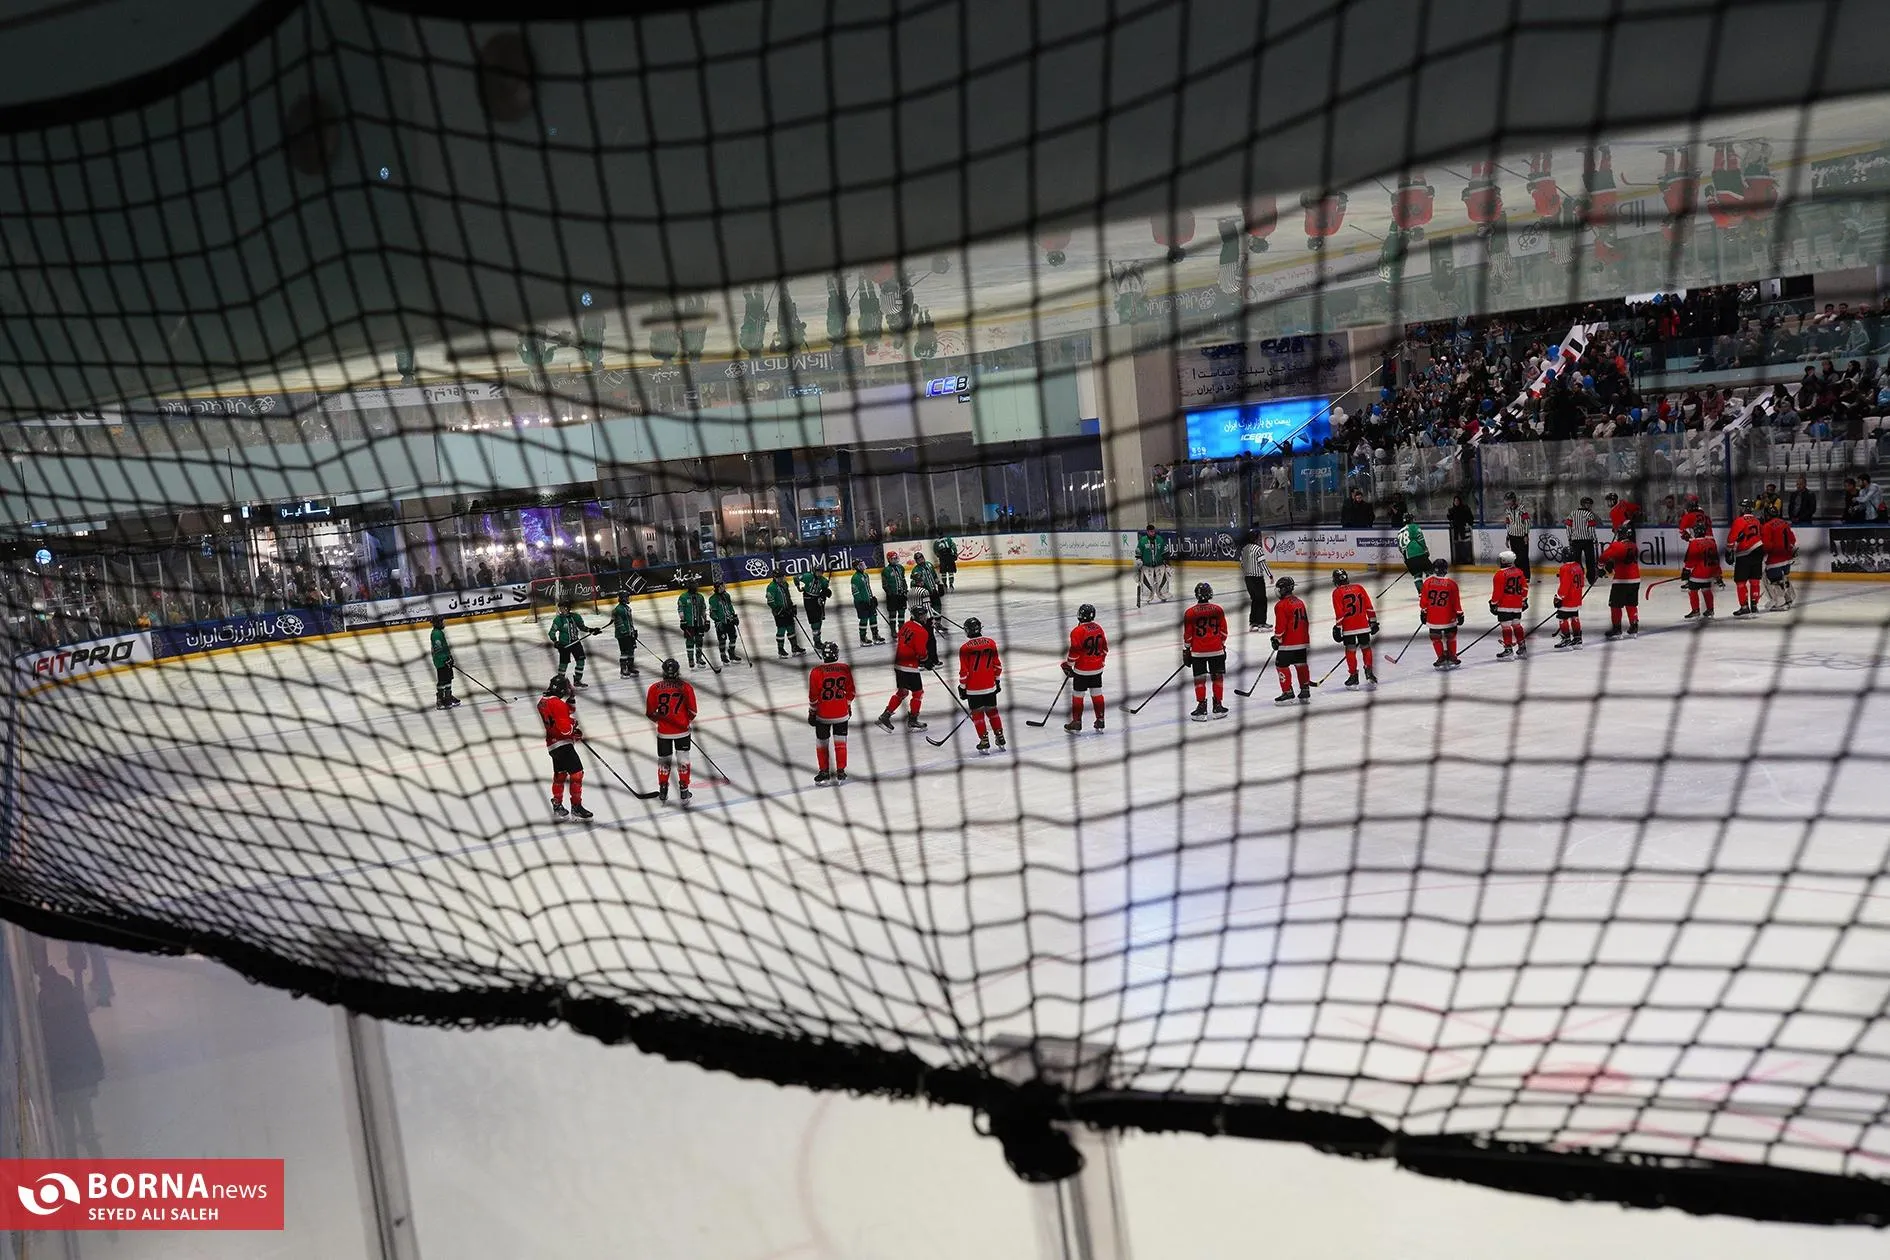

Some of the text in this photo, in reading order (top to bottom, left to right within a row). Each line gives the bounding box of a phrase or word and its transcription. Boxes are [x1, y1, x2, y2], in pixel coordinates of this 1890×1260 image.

[1343, 593, 1363, 617] 31
[1427, 589, 1449, 607] 98
[33, 639, 136, 680] FITPRO
[821, 676, 846, 700] 88
[658, 692, 684, 716] 87
